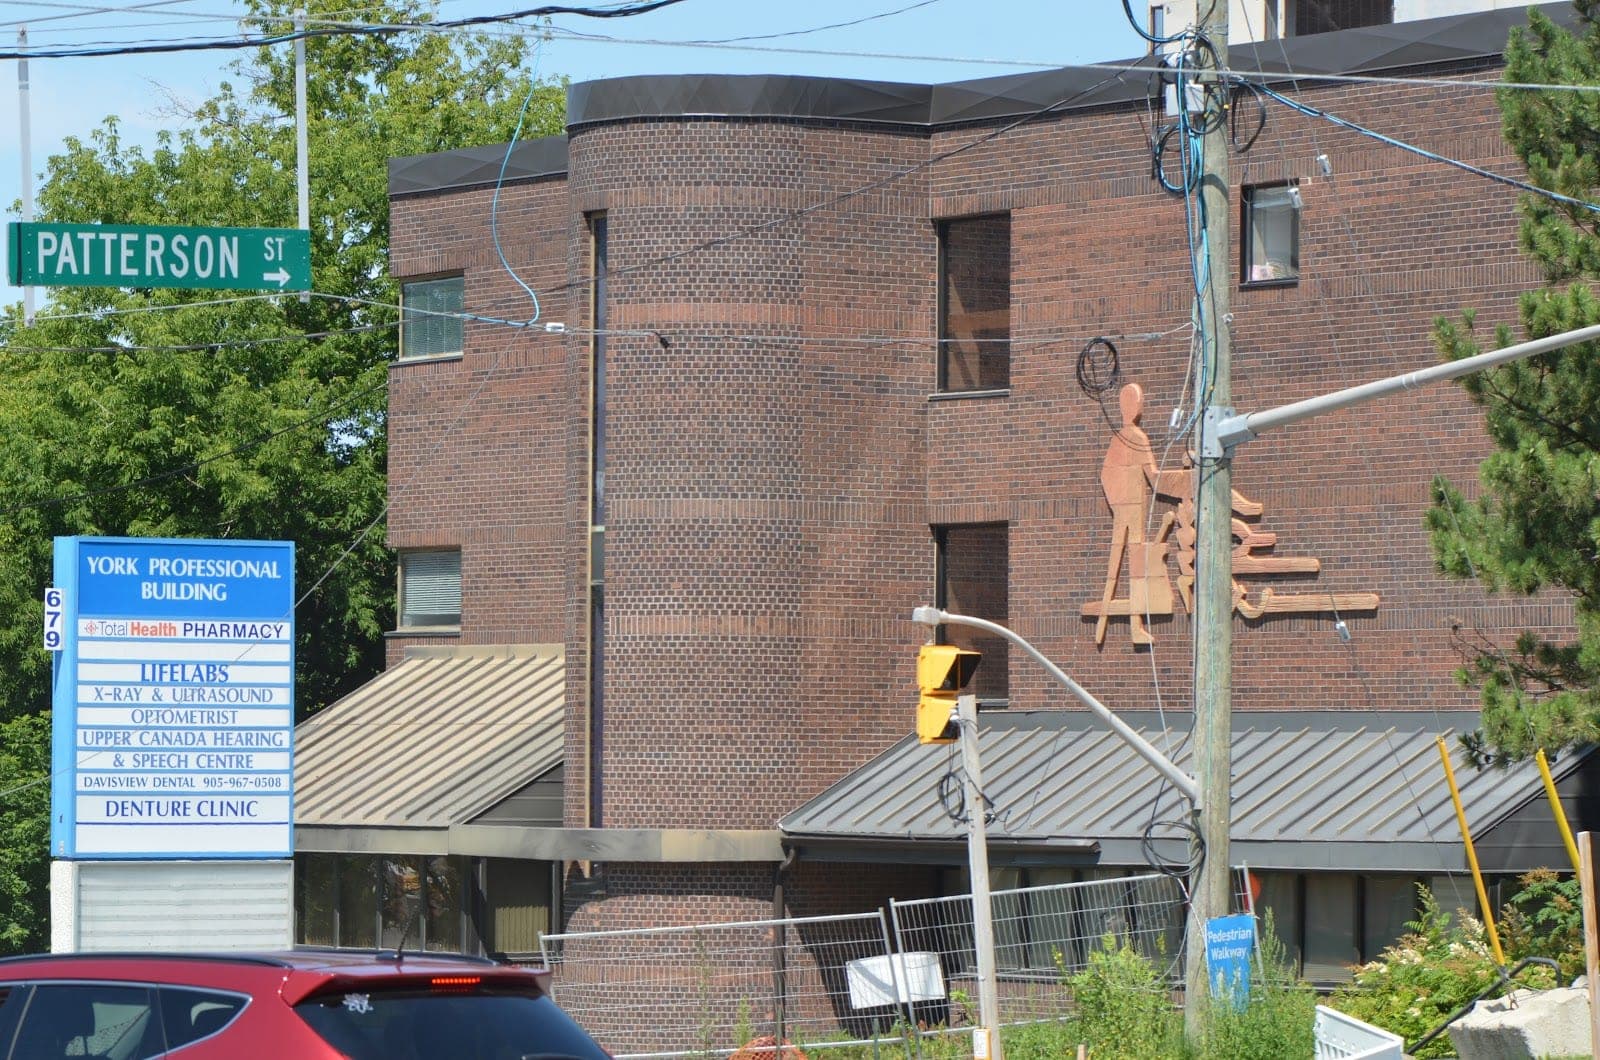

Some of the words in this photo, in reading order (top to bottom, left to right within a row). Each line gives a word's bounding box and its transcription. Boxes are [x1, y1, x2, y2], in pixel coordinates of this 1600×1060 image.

[37, 230, 239, 280] PATTERSON
[263, 236, 285, 262] ST
[86, 556, 139, 576] YORK
[149, 557, 281, 579] PROFESSIONAL
[141, 581, 227, 602] BUILDING
[45, 590, 61, 648] 679
[183, 622, 284, 640] PHARMACY
[140, 663, 229, 683] LIFELABS
[94, 686, 143, 702] X-RAY
[151, 687, 163, 702] &
[171, 687, 273, 704] ULTRASOUND
[131, 708, 238, 725] OPTOMETRIST
[83, 730, 132, 746] UPPER
[139, 731, 207, 747] CANADA
[213, 731, 284, 748] HEARING
[113, 753, 125, 768] &
[132, 753, 189, 769] SPEECH
[196, 753, 254, 769] CENTRE
[84, 776, 149, 789] DAVISVIEW
[152, 776, 196, 789] DENTAL
[203, 777, 282, 789] 905-967-0508
[106, 800, 191, 818] DENTURE
[196, 800, 259, 818] CLINIC
[1207, 928, 1252, 944] Pedestrian
[1211, 946, 1247, 960] Walkway
